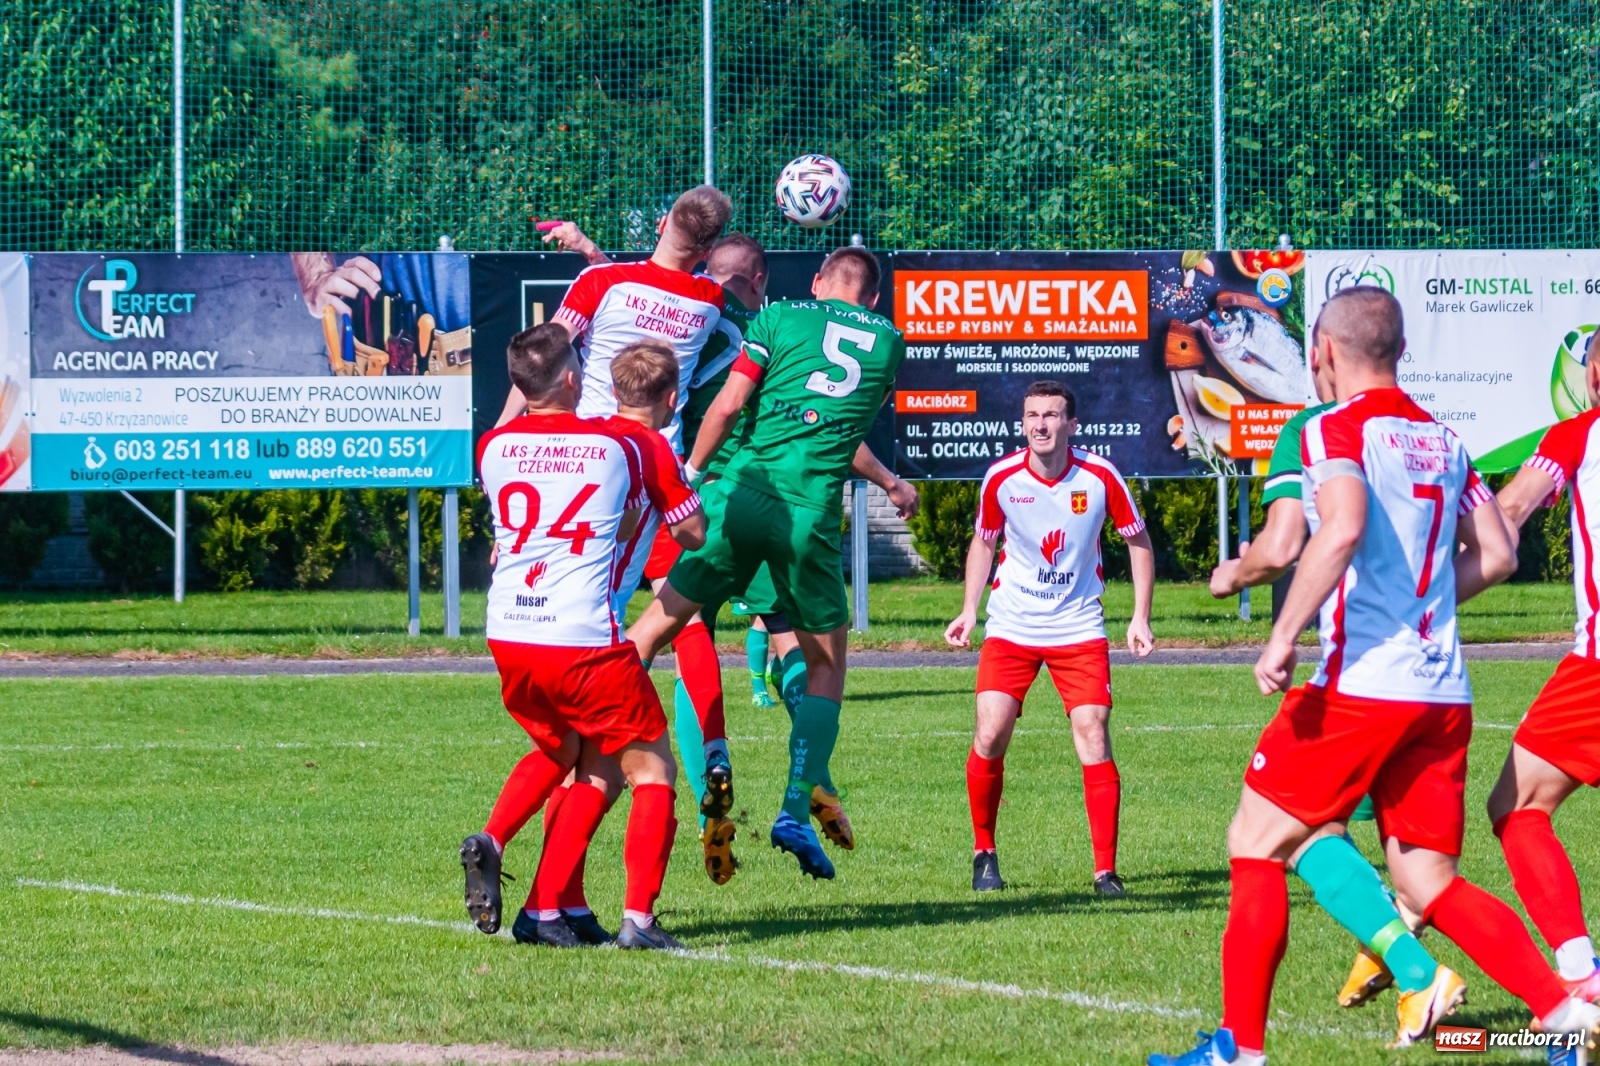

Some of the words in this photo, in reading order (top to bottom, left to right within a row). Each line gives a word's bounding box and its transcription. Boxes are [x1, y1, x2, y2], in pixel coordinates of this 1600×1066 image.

[1425, 278, 1533, 295] GM-INSTAL
[1550, 280, 1579, 294] tel.
[791, 301, 819, 310] LKS
[906, 280, 1138, 315] KREWETKA
[88, 279, 165, 339] TEAM
[625, 294, 648, 312] LKS
[650, 301, 708, 329] ZAMECZEK
[1426, 302, 1466, 312] Marek
[1470, 301, 1534, 312] Gawliczek
[635, 314, 689, 341] CZERNICA
[906, 321, 956, 334] SKLEP
[961, 321, 1014, 333] RYBNY
[1023, 321, 1034, 333] &
[1044, 318, 1137, 333] SMAŻALNIA
[804, 320, 877, 398] 5
[906, 346, 940, 359] RYBY
[944, 343, 997, 361] ŚWIEŻE,
[1001, 343, 1071, 360] MROŻONE,
[1075, 346, 1140, 361] WĘDZONE
[53, 352, 148, 371] AGENCJA
[152, 351, 219, 370] PRACY
[956, 362, 1003, 373] MORSKIE
[1005, 362, 1009, 372] I
[1012, 362, 1090, 373] SŁODKOWODNE
[59, 387, 133, 406] Wyzwolenia
[135, 388, 142, 402] 2
[175, 386, 303, 402] POSZUKUJEMY
[308, 383, 441, 401] PRACOWNIKÓW
[906, 394, 967, 408] RACIBÓRZ
[59, 412, 102, 426] 47-450
[106, 411, 188, 429] Krzyżanowice
[221, 408, 246, 424] DO
[251, 405, 320, 423] BRANŻY
[325, 407, 441, 422] BUDOWALNEJ
[1237, 409, 1245, 419] U
[1248, 409, 1269, 419] NAS
[907, 424, 927, 436] UL.
[931, 421, 1009, 436] ZBOROWA
[1084, 424, 1106, 435] 415
[1109, 424, 1123, 435] 22
[1126, 423, 1141, 435] 32
[1240, 424, 1248, 434] Z
[114, 440, 155, 460] 603
[162, 440, 200, 460] 251
[210, 439, 249, 459] 118
[256, 438, 289, 458] lub
[296, 438, 336, 458] 889
[343, 437, 382, 457] 620
[389, 437, 426, 457] 551
[502, 445, 528, 458] LKS
[533, 446, 607, 460] ZAMECZEK
[907, 445, 927, 457] UL.
[932, 443, 990, 457] OCICKA
[995, 442, 1004, 457] 5
[1245, 440, 1275, 452] WĘDZ
[70, 468, 252, 484] biuro@perfect-team.eu
[269, 465, 433, 481] www.perfect-team.eu
[518, 461, 584, 474] CZERNICA
[498, 481, 601, 556] 94
[1413, 483, 1444, 598] 7
[1037, 566, 1074, 585] Husar
[515, 593, 548, 608] Husar
[1020, 586, 1055, 600] GALERIA
[503, 613, 531, 621] GALERIA
